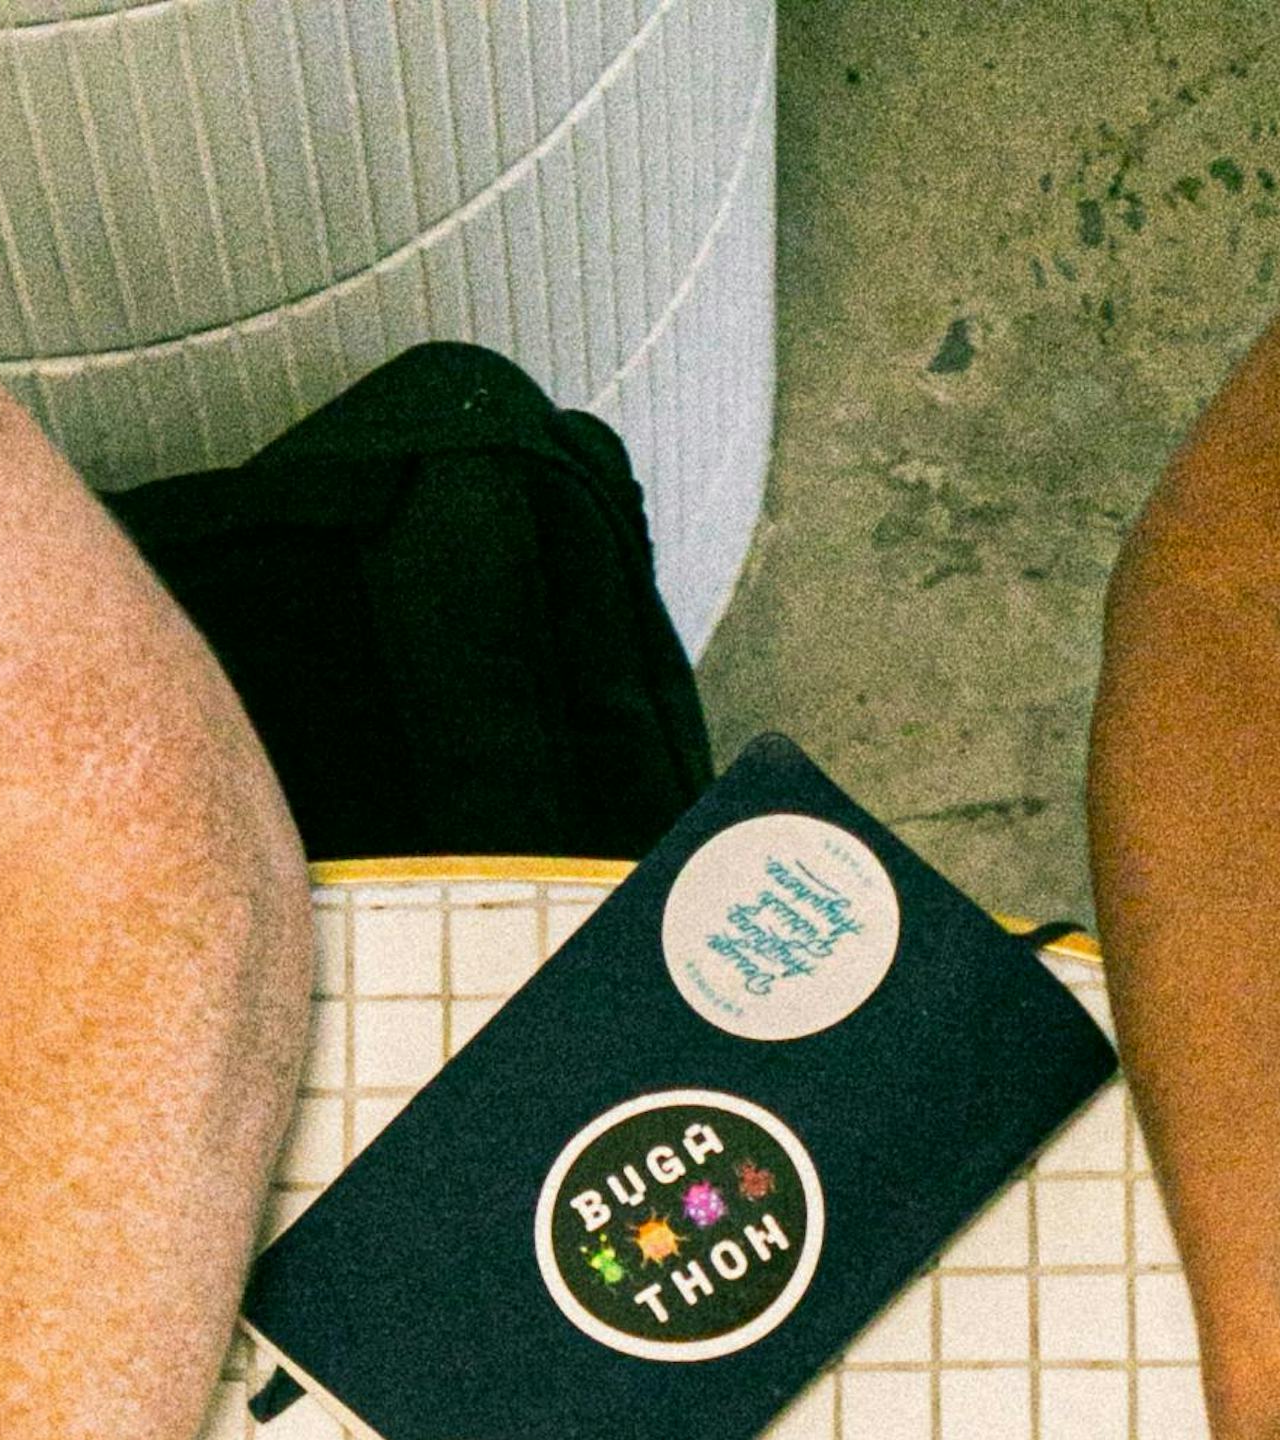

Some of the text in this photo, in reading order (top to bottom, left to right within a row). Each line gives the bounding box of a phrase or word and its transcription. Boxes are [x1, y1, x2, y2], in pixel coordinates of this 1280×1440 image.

[727, 908, 814, 977] Anything
[758, 889, 835, 955] Publish
[706, 938, 774, 995] Design
[569, 1123, 725, 1233] BUGA
[632, 1212, 791, 1324] THON
